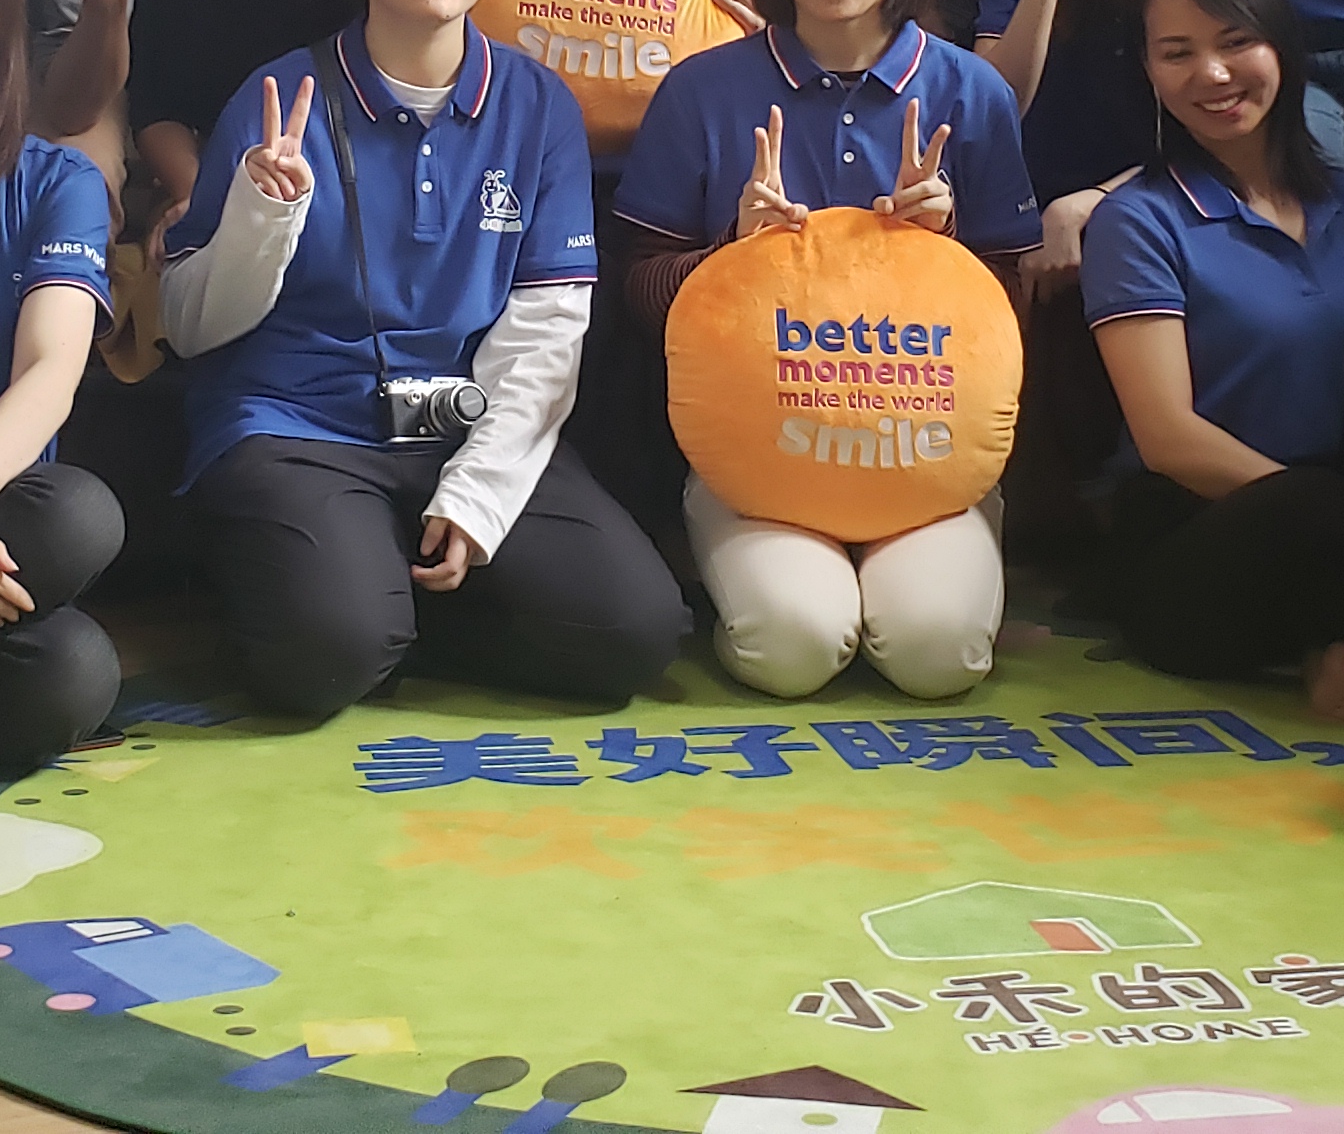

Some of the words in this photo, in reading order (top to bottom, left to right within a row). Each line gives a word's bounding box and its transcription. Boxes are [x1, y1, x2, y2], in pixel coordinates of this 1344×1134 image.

[518, 0, 573, 21] make
[580, 6, 614, 27] the
[619, 15, 675, 36] world
[516, 23, 671, 80] smile
[41, 242, 83, 255] MARS
[567, 234, 591, 249] MARS
[775, 307, 953, 356] better
[777, 358, 955, 388] moments
[777, 388, 840, 408] make
[846, 389, 885, 410] the
[891, 392, 955, 412] world
[777, 416, 954, 469] smile
